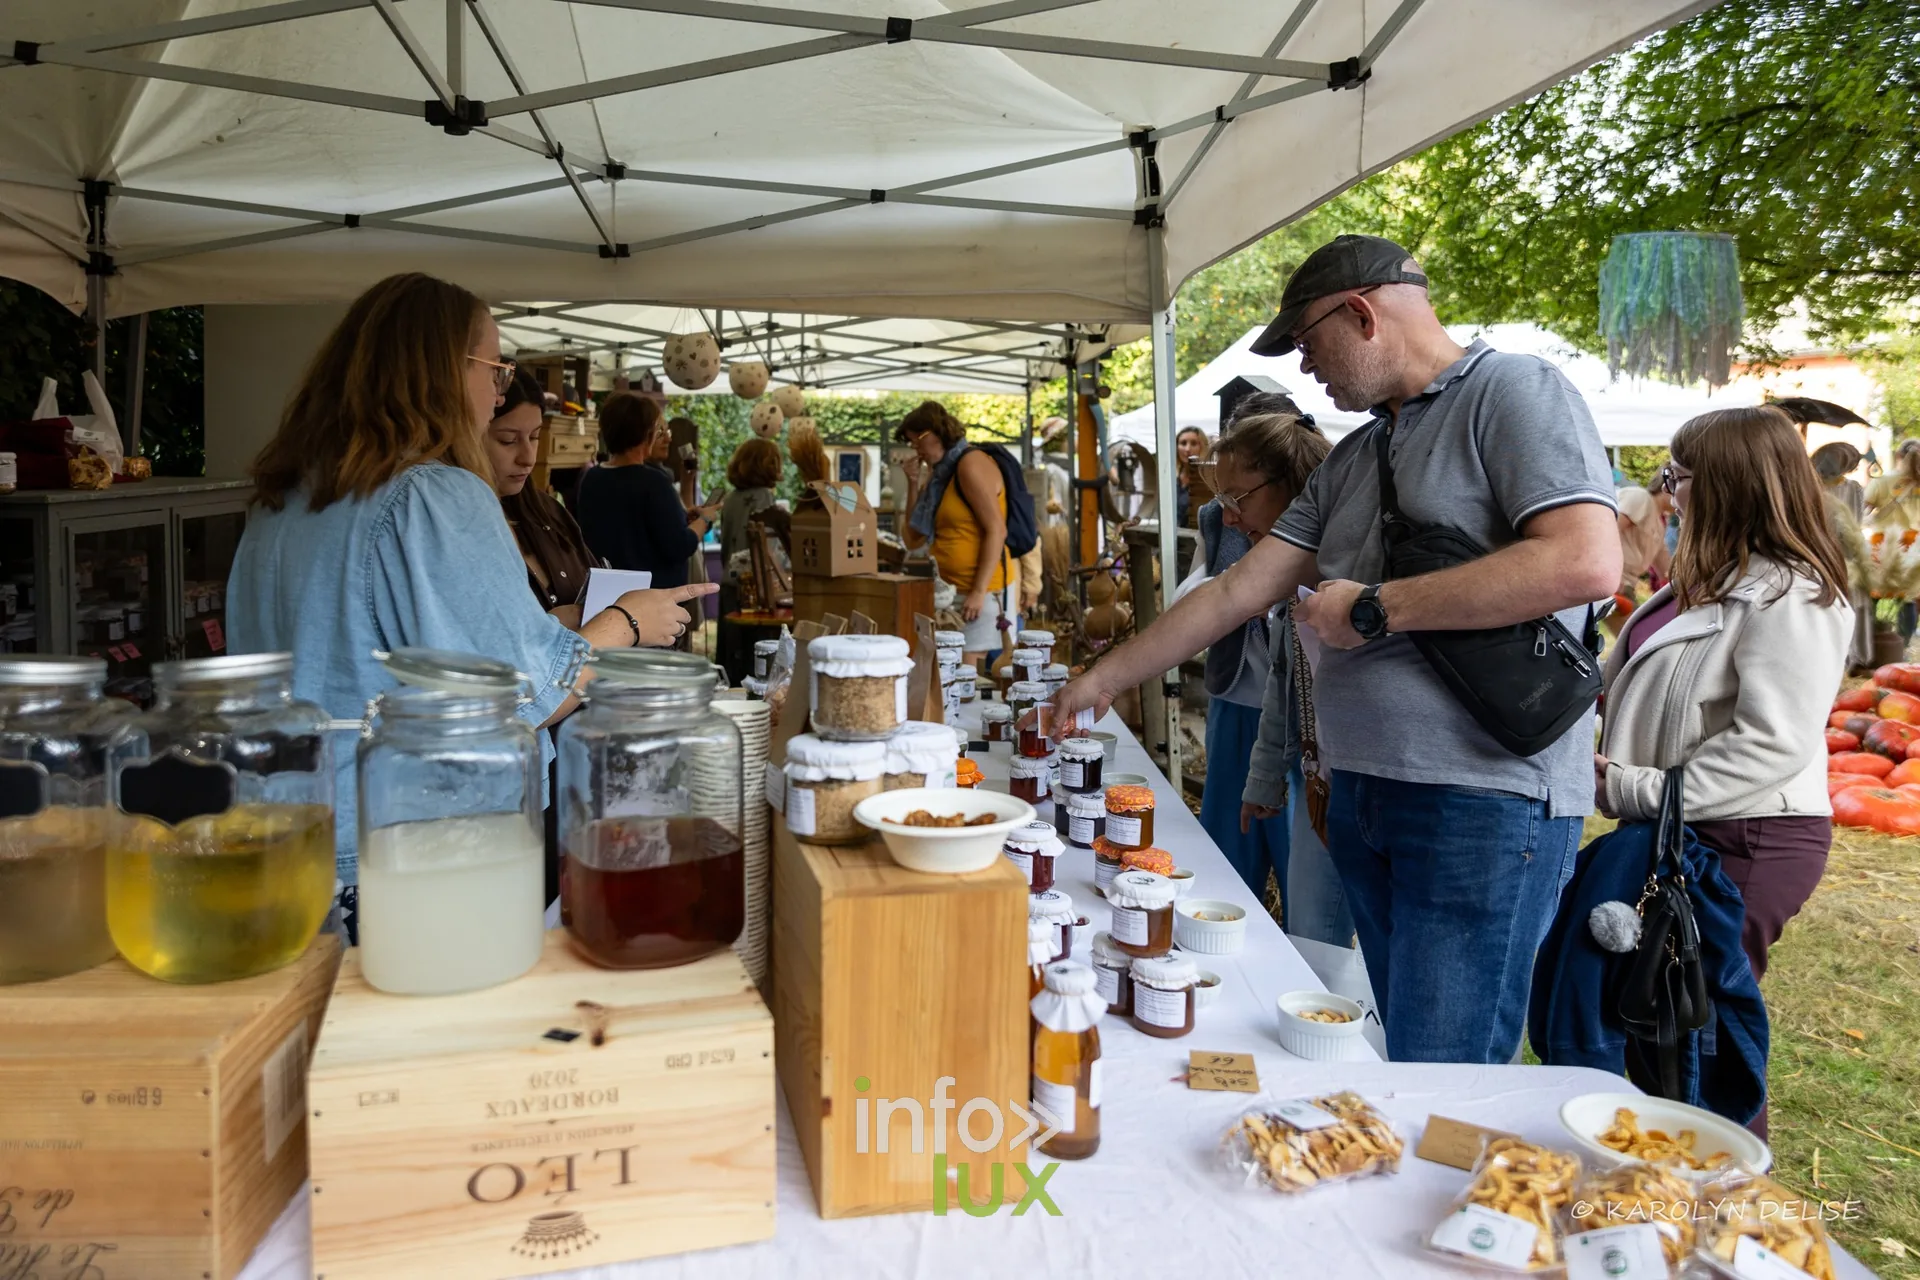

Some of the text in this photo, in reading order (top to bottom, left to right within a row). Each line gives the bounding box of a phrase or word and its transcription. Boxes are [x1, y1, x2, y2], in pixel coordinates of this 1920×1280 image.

[528, 1068, 579, 1089] 2020
[484, 1087, 620, 1118] BORDEAUX
[465, 1145, 640, 1206] LÉO
[32, 1189, 75, 1230] de
